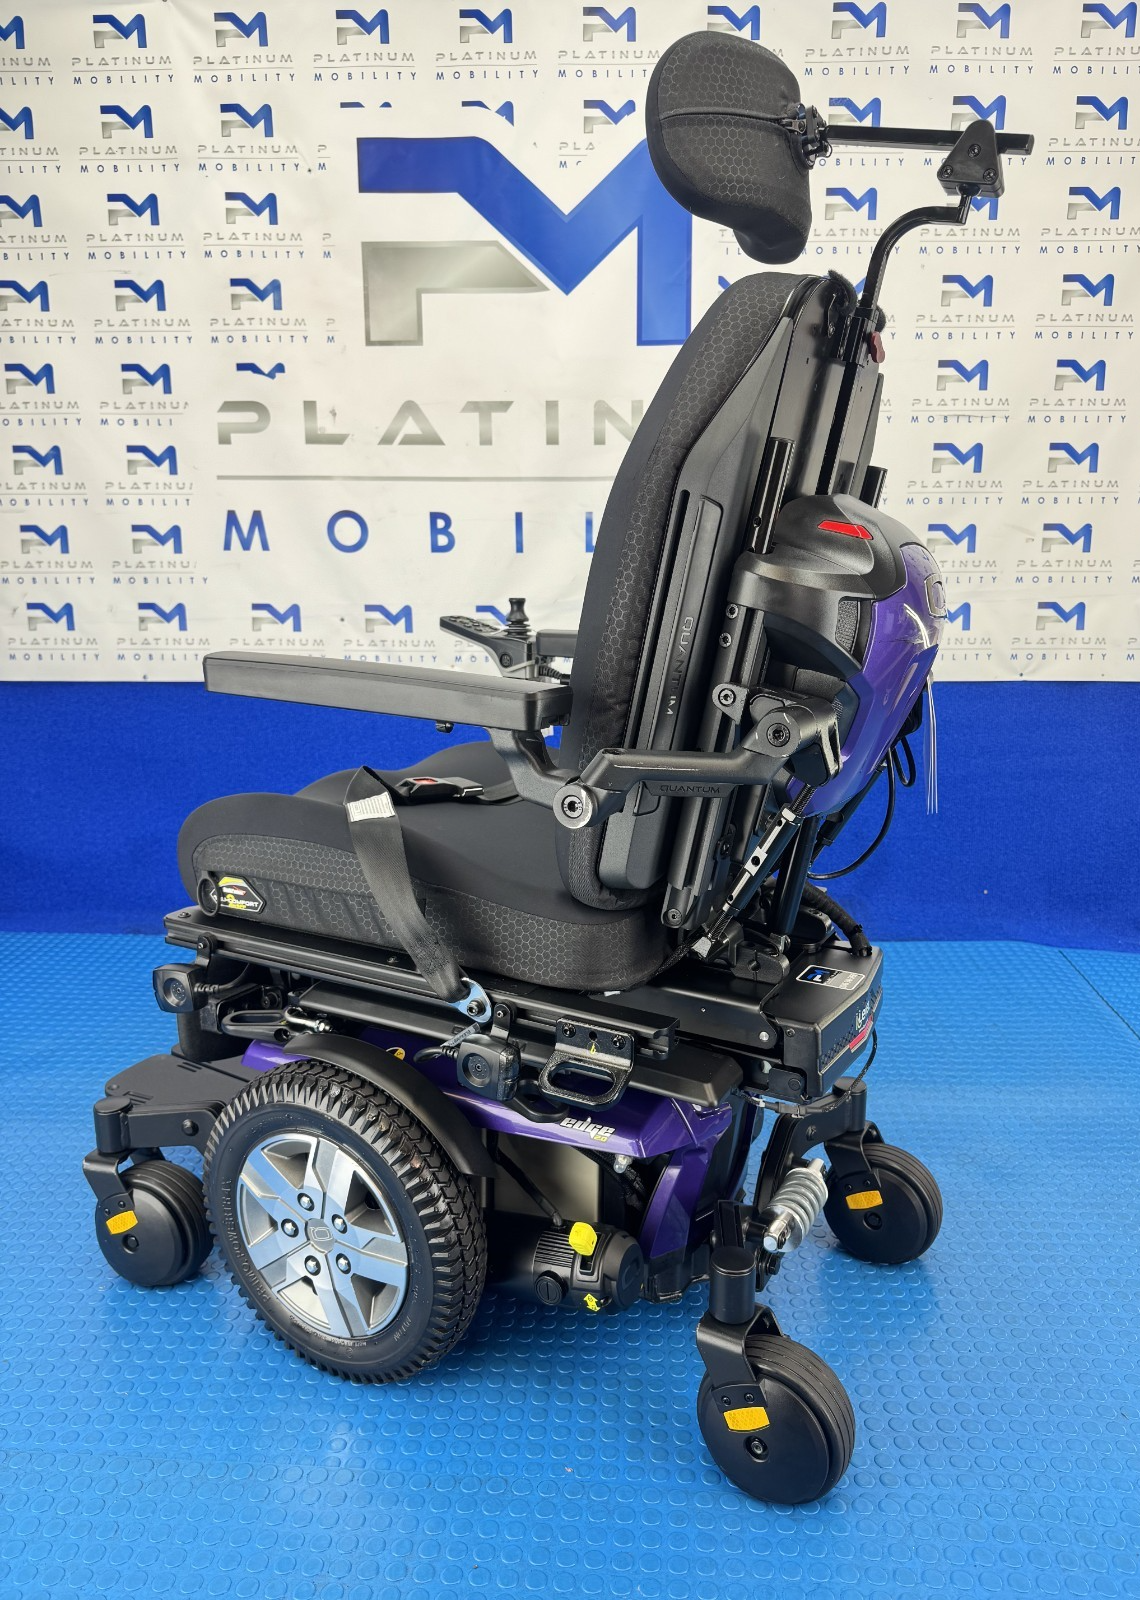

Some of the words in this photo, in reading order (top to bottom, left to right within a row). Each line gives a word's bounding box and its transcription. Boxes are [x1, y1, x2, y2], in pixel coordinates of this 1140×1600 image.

[804, 45, 910, 57] PLATINUM
[930, 45, 1033, 55] PLATINUM
[1053, 45, 1140, 55] PLATINU
[71, 55, 172, 66] PLATINUM
[192, 53, 294, 64] PLATINUM
[313, 51, 415, 62] PLATINUM
[435, 50, 537, 61] PLATINUM
[1, 56, 51, 66] INUM
[557, 69, 648, 78] MOBILIT
[804, 65, 910, 75] MOBILITY
[928, 64, 1034, 74] MOBILITY
[1052, 65, 1140, 75] MOBILI
[73, 74, 174, 84] MOBILITY
[193, 72, 295, 83] MOBILITY
[313, 71, 417, 81] MOBILITY
[435, 69, 539, 80] MOBILITY
[0, 76, 54, 86] ILITY
[1048, 137, 1140, 147] PLATINU
[0, 146, 59, 156] TINUM
[78, 145, 178, 155] PLATINUM
[197, 144, 298, 154] PLATINUM
[819, 158, 904, 167] OBILITY
[1045, 156, 1136, 166] MOBILIT
[7, 165, 61, 174] ILITY
[80, 163, 180, 173] MOBILITY
[198, 162, 300, 172] MOBILITY
[85, 232, 184, 242] PLATINUM
[202, 231, 303, 241] PLATINUM
[814, 228, 882, 237] LATINU
[920, 228, 1020, 237] PLATINUM
[0, 234, 67, 244] ATINUM
[87, 250, 186, 260] MOBILITY
[204, 249, 305, 259] MOBILITY
[918, 245, 1021, 255] MOBILITY
[3, 252, 70, 261] BILITY
[0, 318, 75, 328] ATINUM
[93, 318, 191, 328] PLATINUM
[209, 317, 307, 327] PLATINUM
[915, 313, 1015, 323] PLATINUM
[1035, 313, 1134, 323] PLATINUM
[0, 335, 77, 345] BILITY
[94, 335, 193, 345] MOBILITY
[210, 334, 309, 344] MOBILITY
[914, 331, 1016, 341] MOBILITY
[1034, 330, 1134, 340] MOBILITY
[0, 400, 80, 410] LATINUM
[911, 397, 1010, 407] PLATINUM
[1029, 397, 1127, 407] PLATINUM
[1, 417, 82, 427] OBILITY
[100, 417, 173, 427] MOBILI
[216, 400, 643, 446] PLATIN
[910, 413, 1011, 423] MOBILITY
[1027, 415, 1127, 424] MOBILITY
[907, 479, 1003, 489] PLATINUM
[1022, 479, 1119, 489] PLATINUM
[0, 497, 89, 507] OBILITY
[105, 497, 190, 507] MOBILIT
[905, 496, 1003, 505] MOBILITY
[1021, 496, 1119, 505] MOBILITY
[223, 510, 595, 554] MOBIL
[0, 559, 94, 569] PLATINUM
[111, 559, 197, 569] PLATINU
[939, 559, 998, 569] TINUM
[1016, 559, 1113, 568] PLATINUM
[1, 576, 95, 585] MOBILITY
[112, 576, 208, 585] MOBILITY
[945, 575, 998, 585] ILITY
[1015, 575, 1113, 584] MOBILITY
[7, 636, 98, 646] PLATINUM
[116, 636, 211, 646] PLATINUM
[229, 637, 325, 647] PLATINUM
[343, 638, 436, 648] PLATINUM
[946, 636, 993, 646] INUM
[1011, 636, 1107, 646] PLATINUM
[8, 652, 100, 662] MOBILITY
[116, 652, 199, 662] MOBILIT
[344, 655, 437, 663] MOBILITY
[941, 652, 992, 661] ILITY
[1009, 652, 1107, 661] MOBILITY
[659, 784, 721, 795] QUANTUM
[560, 1116, 616, 1139] edge
